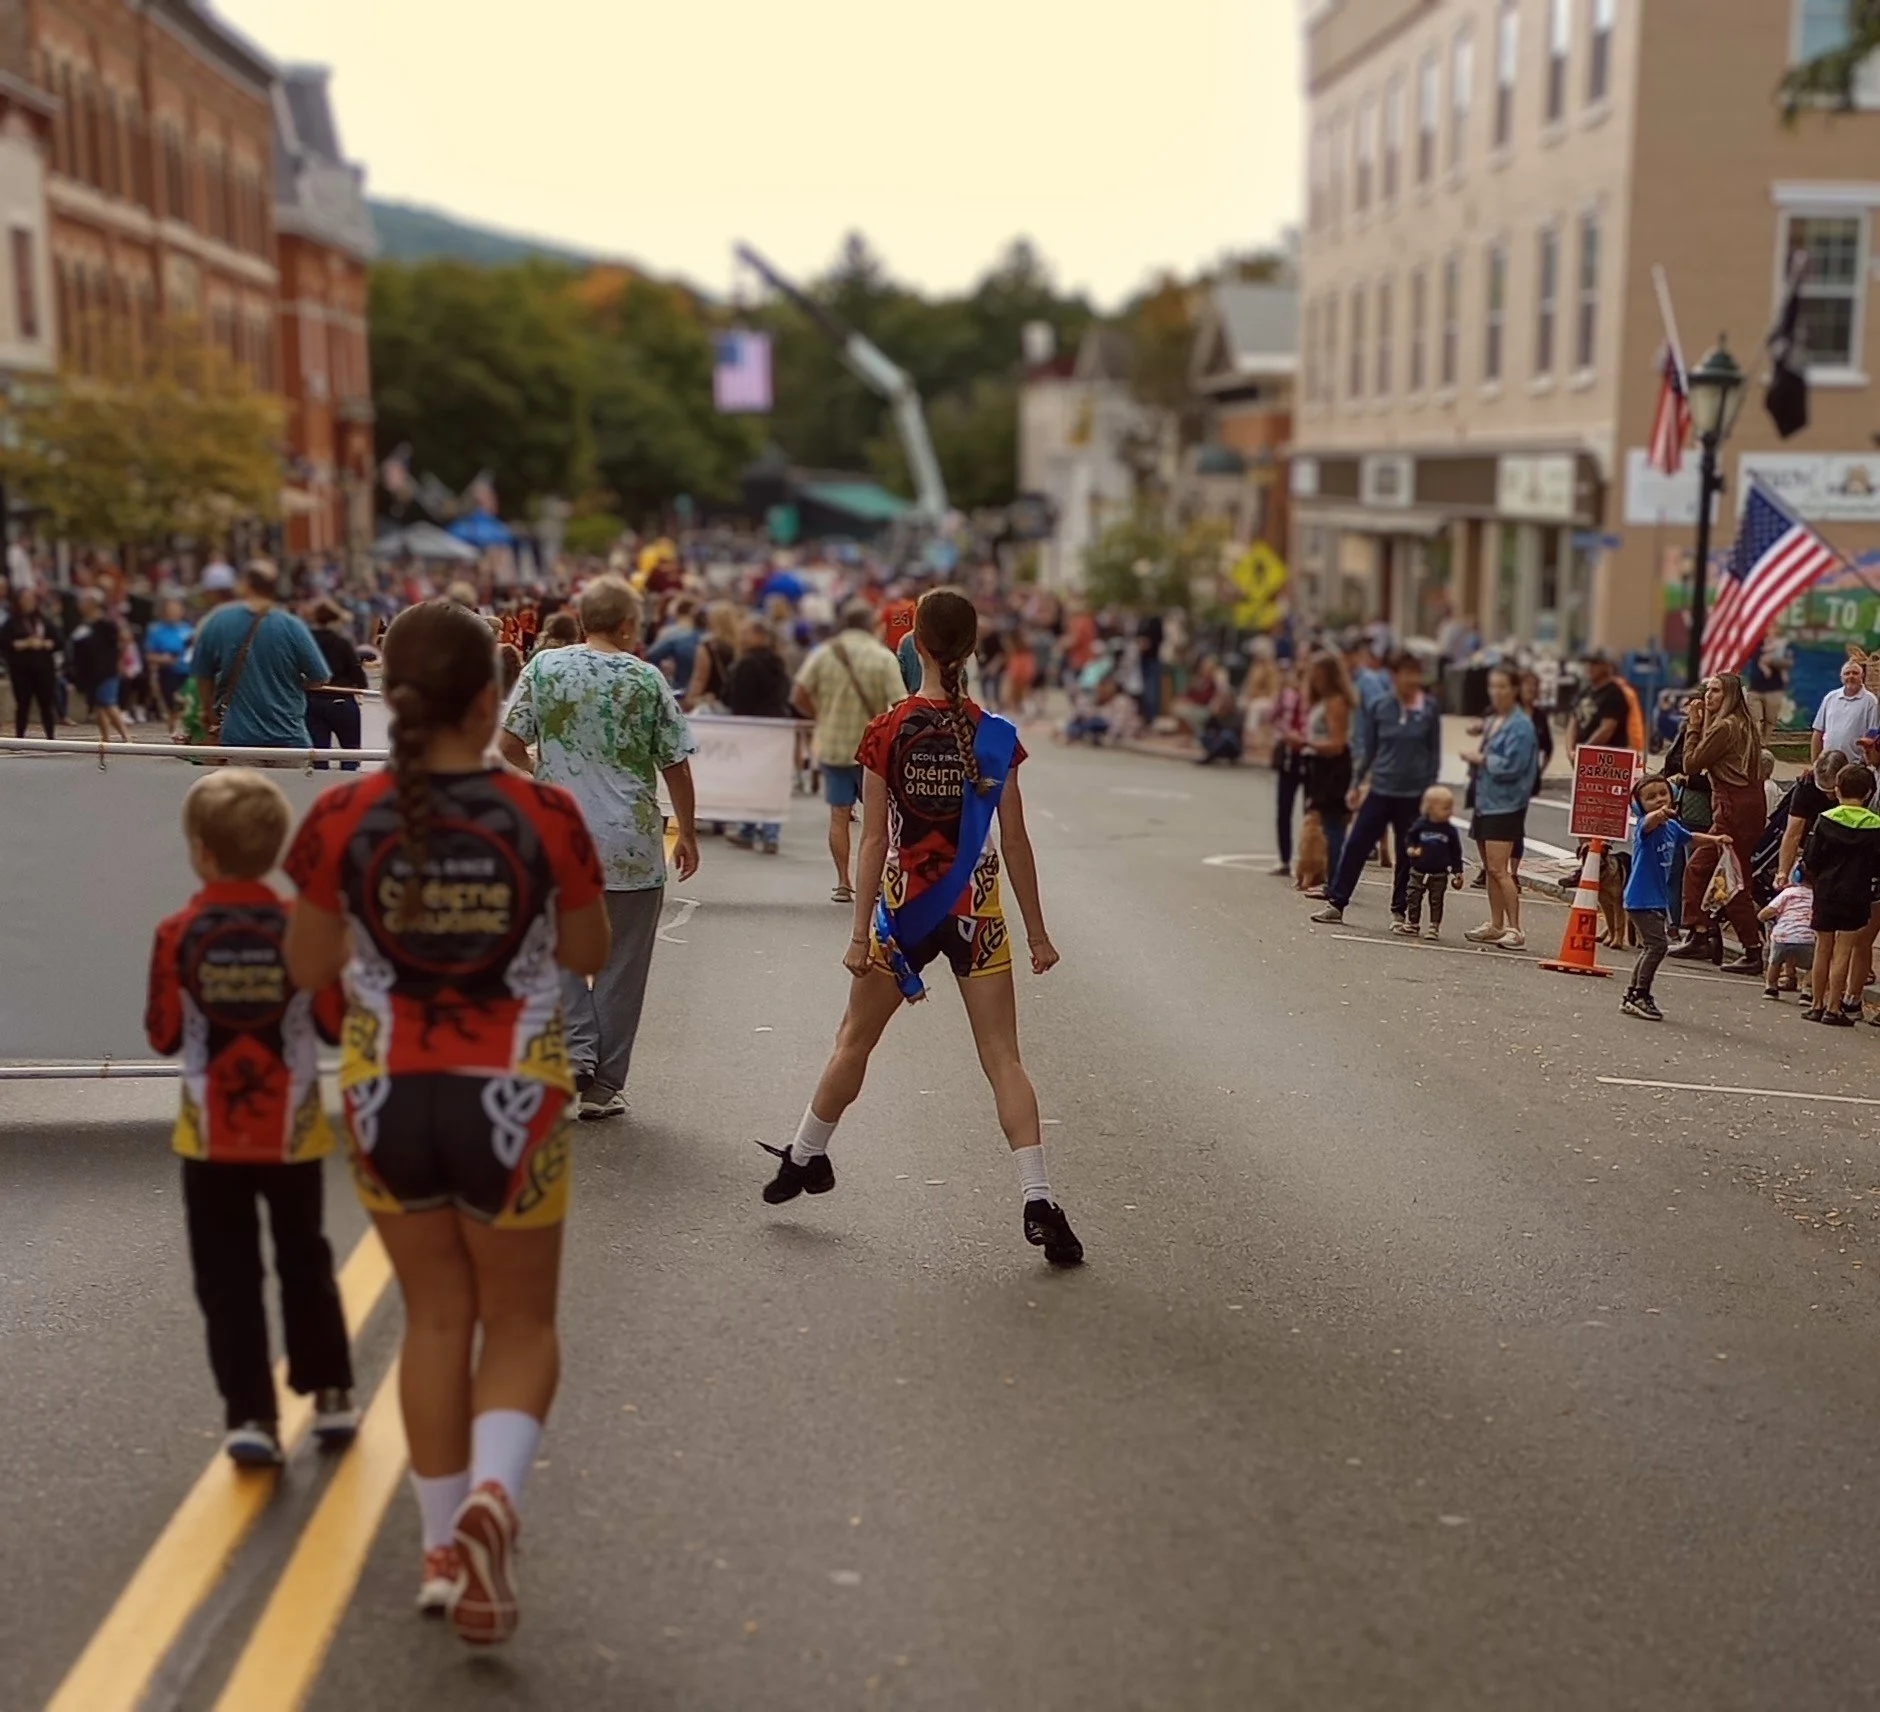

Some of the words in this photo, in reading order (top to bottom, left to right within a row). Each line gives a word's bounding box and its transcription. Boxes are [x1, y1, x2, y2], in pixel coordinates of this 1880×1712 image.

[1824, 596, 1858, 630] TO
[1598, 753, 1615, 766] NO
[1579, 765, 1630, 781] PARKING
